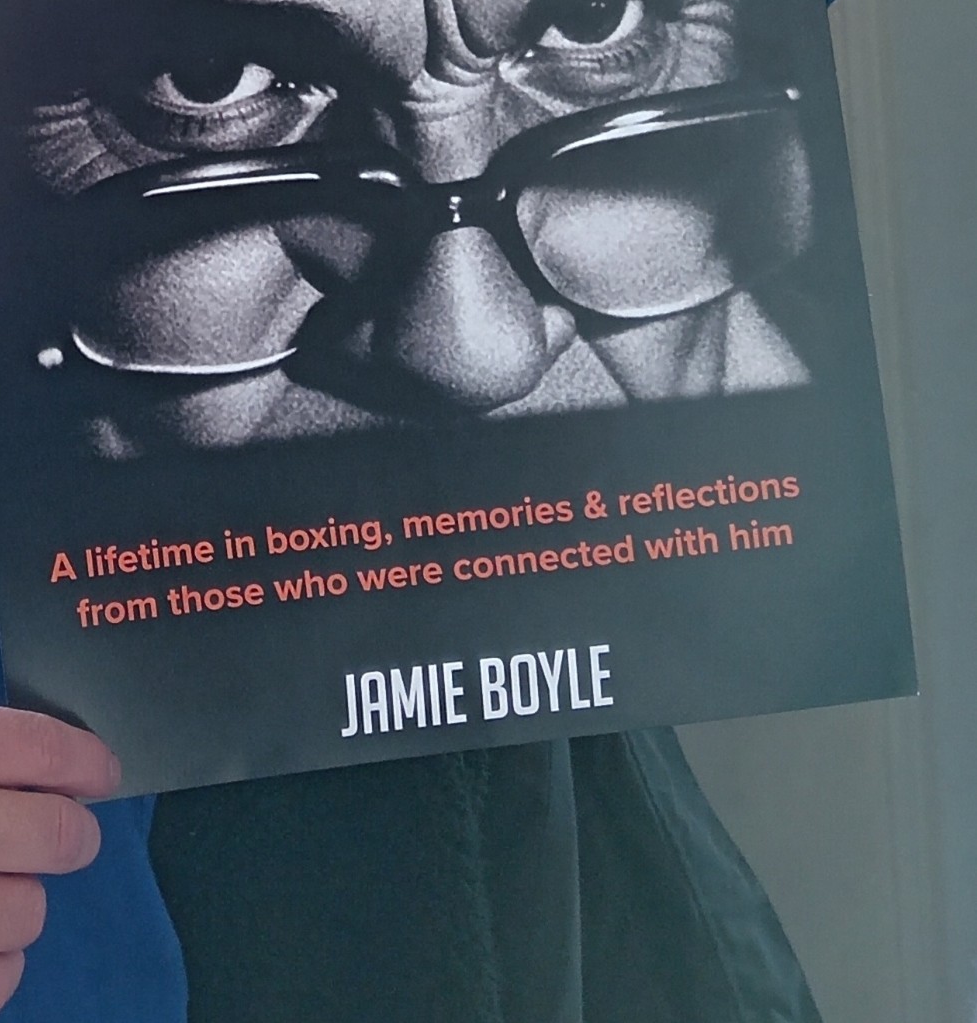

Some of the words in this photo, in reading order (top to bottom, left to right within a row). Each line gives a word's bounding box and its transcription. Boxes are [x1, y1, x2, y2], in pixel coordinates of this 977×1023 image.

[51, 552, 76, 582] A
[86, 539, 214, 577] lifetime
[224, 529, 256, 559] in
[266, 517, 393, 554] boxing,
[403, 496, 573, 538] memories
[584, 491, 607, 518] &
[619, 475, 800, 515] reflections
[76, 596, 157, 627] from
[167, 583, 264, 615] those
[273, 570, 348, 601] who
[357, 562, 441, 591] were
[454, 535, 634, 580] connected
[645, 527, 719, 559] with
[729, 520, 794, 550] him
[341, 662, 467, 737] JAMIE
[480, 645, 614, 719] BOYLE
